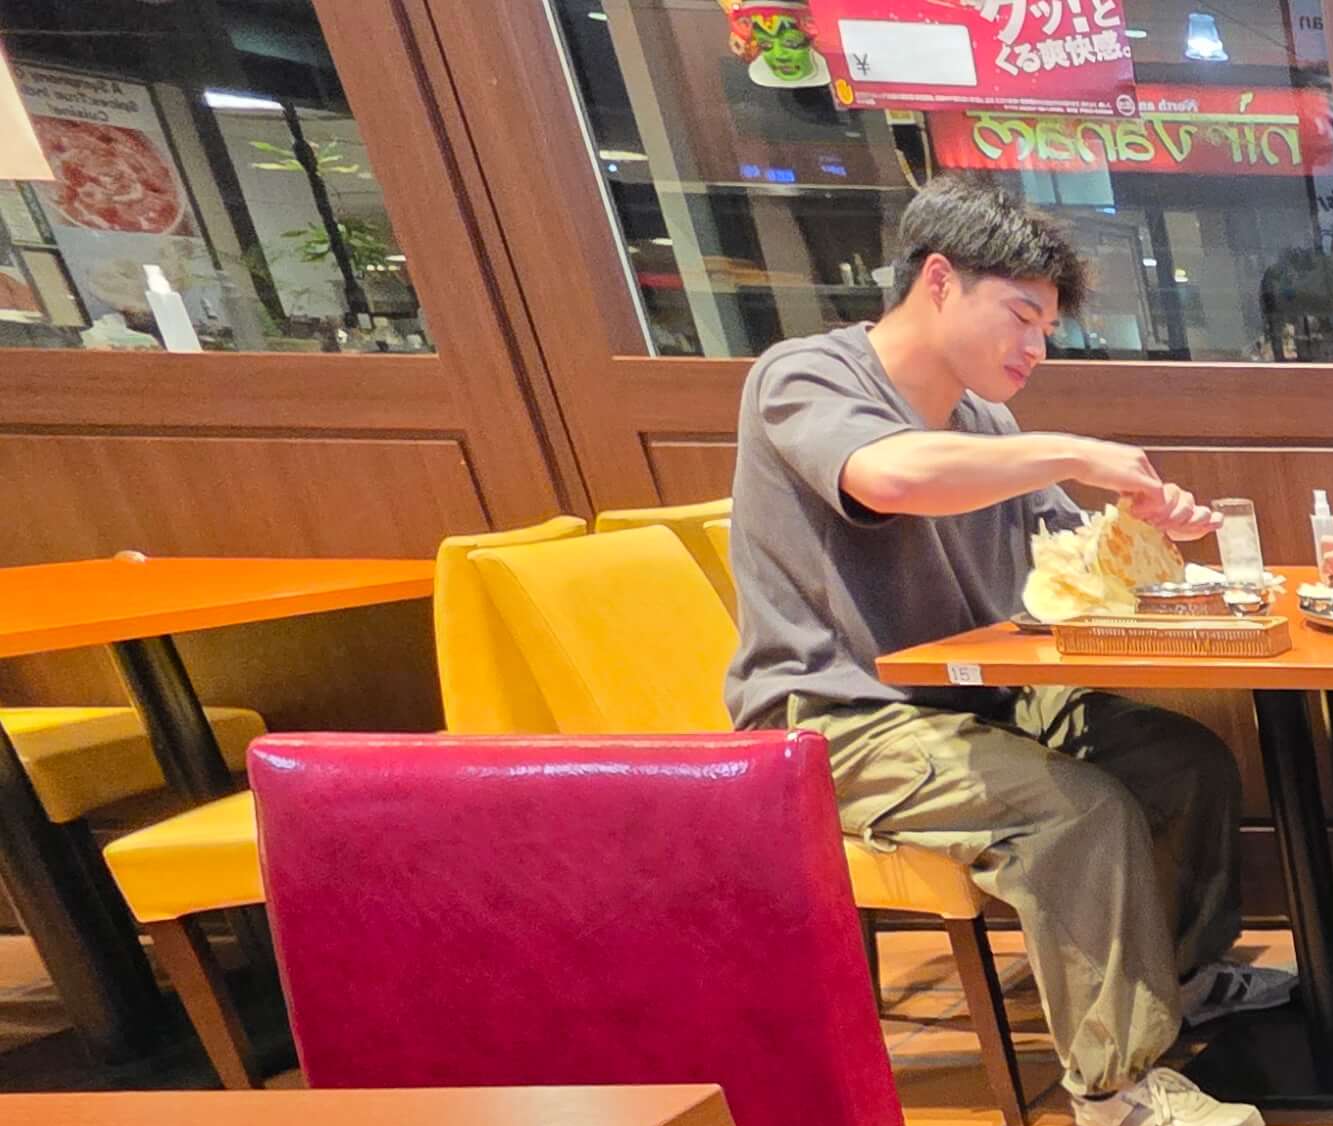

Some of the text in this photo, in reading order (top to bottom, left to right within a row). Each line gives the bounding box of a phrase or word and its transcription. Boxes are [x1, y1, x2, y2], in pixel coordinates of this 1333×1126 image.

[852, 53, 870, 76] ¥
[995, 29, 1132, 76] くる爽快感。
